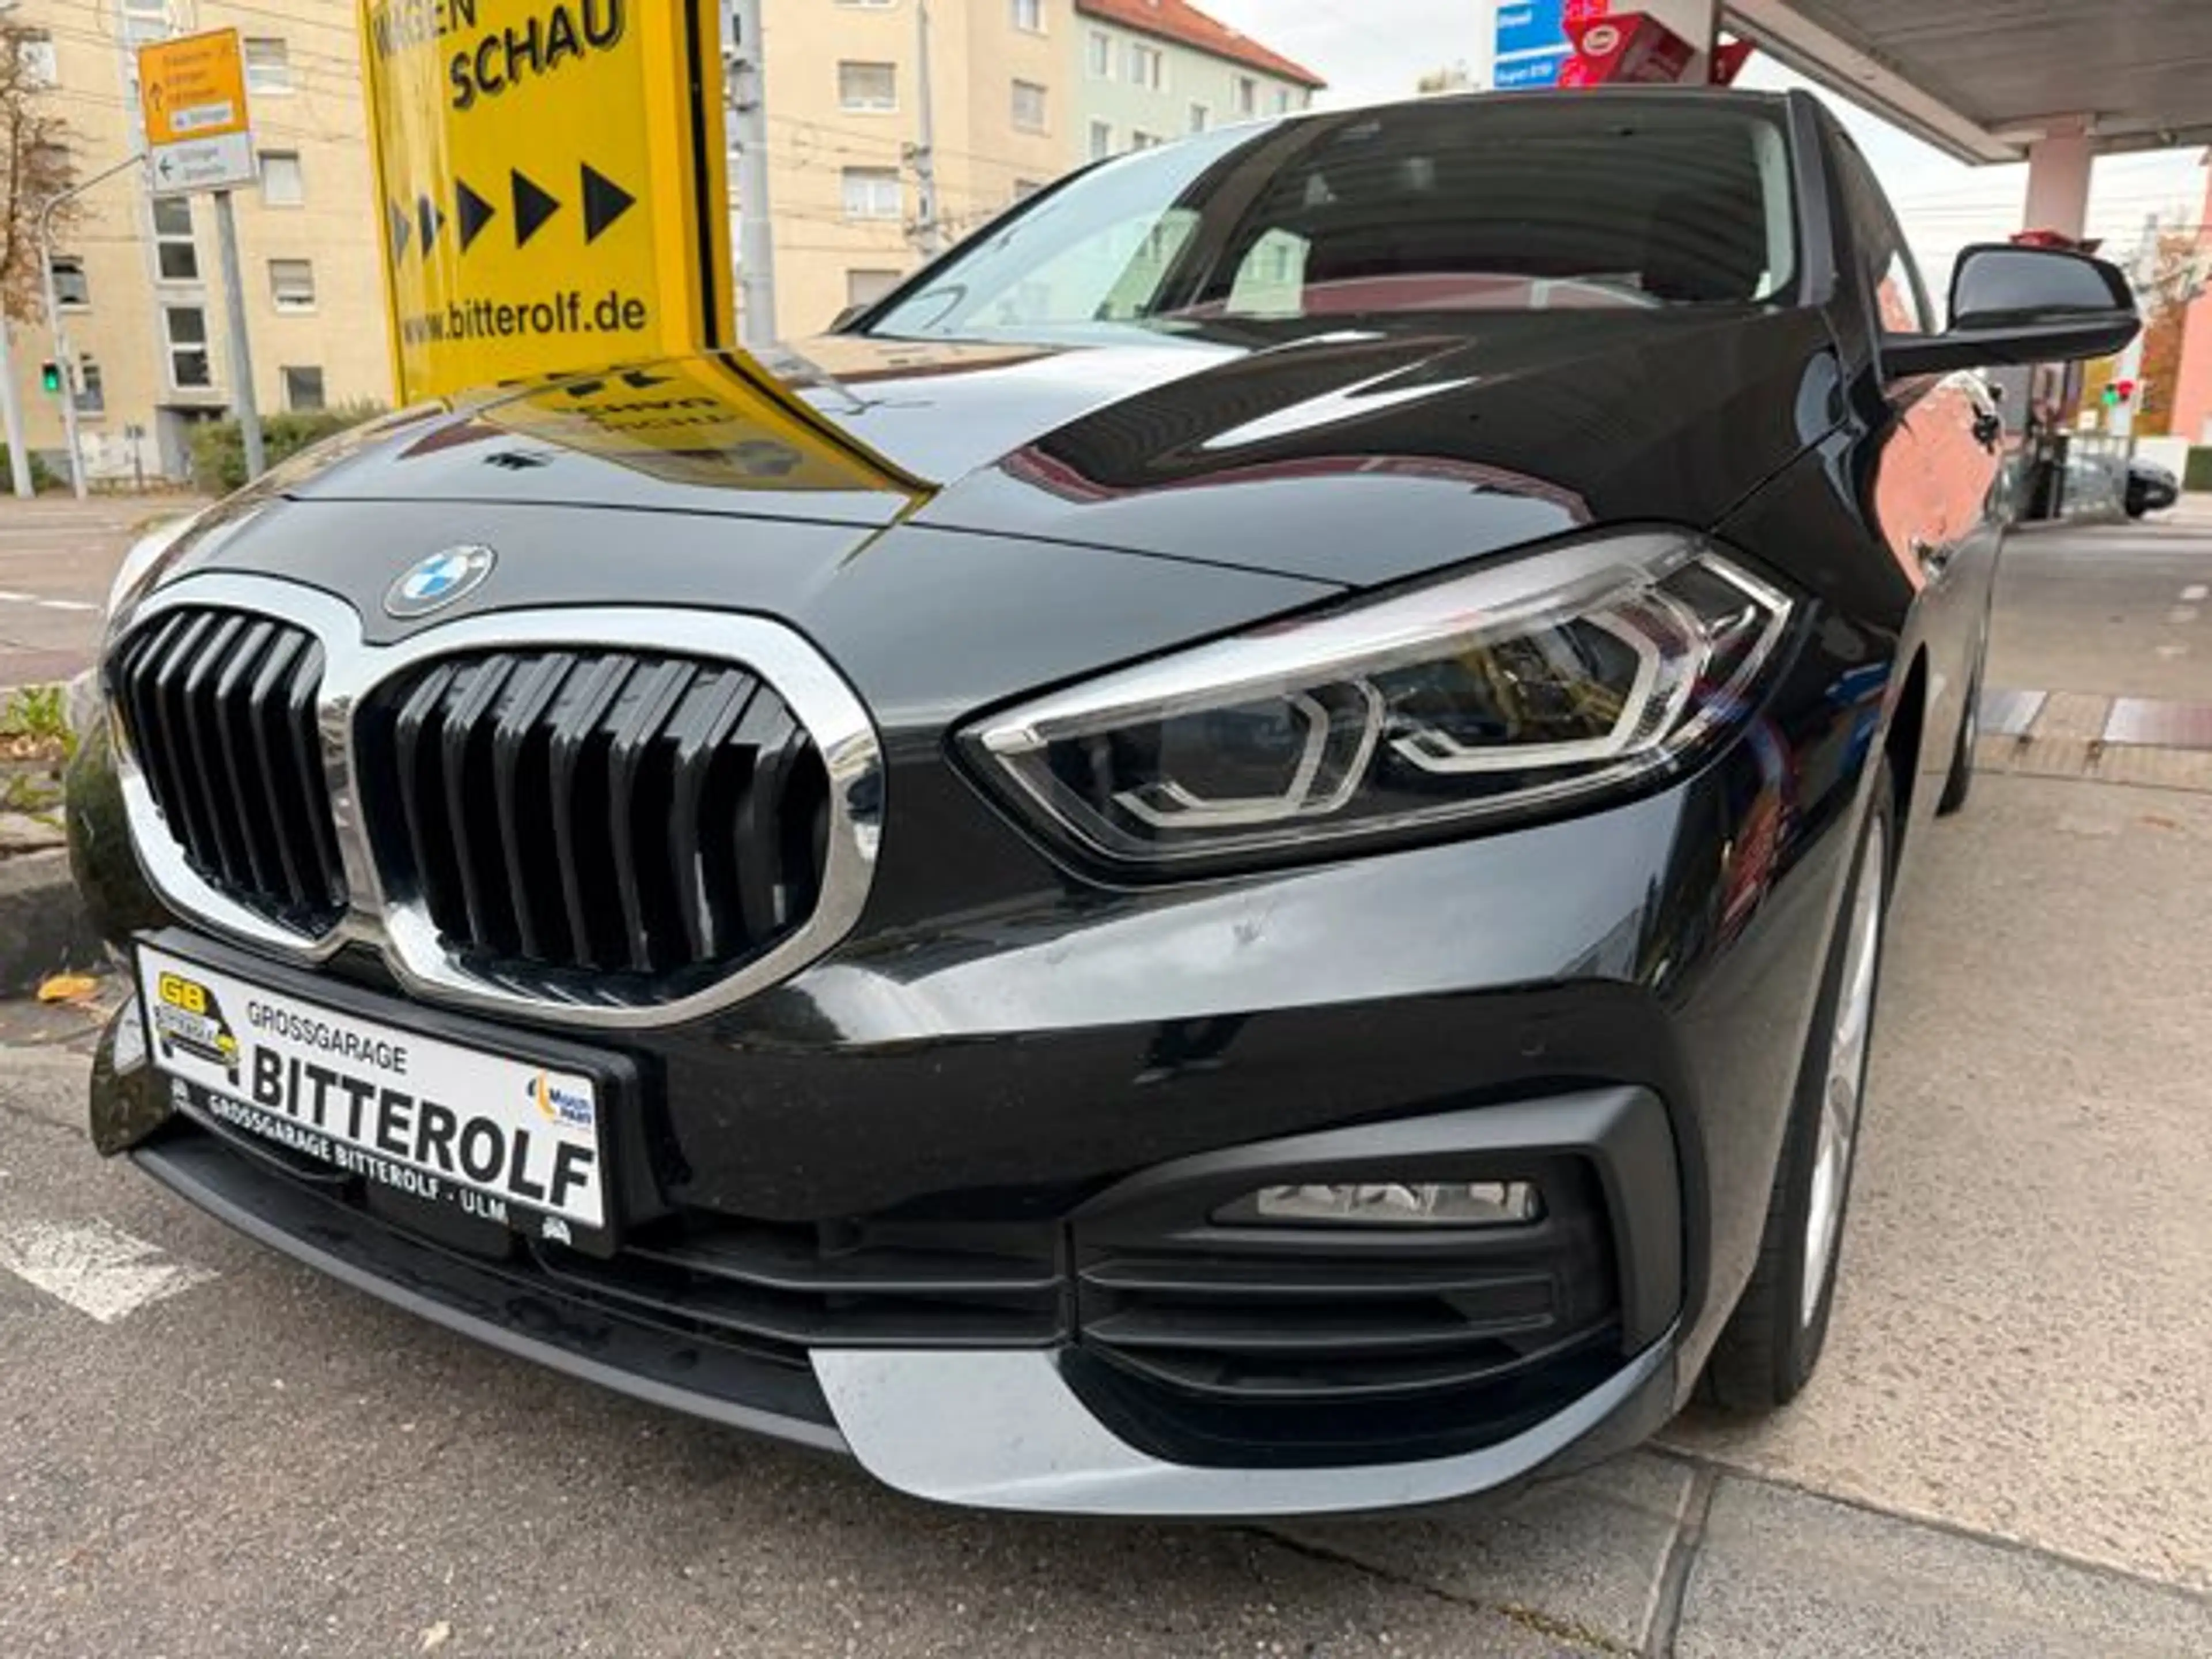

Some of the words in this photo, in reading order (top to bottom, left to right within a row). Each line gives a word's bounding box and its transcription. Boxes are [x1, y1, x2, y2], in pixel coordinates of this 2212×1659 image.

[449, 0, 626, 110] SCHAU
[404, 290, 646, 344] www.bitterolf.de
[160, 972, 206, 1014] GB
[248, 1000, 408, 1075] GROSSGARAGE
[208, 1094, 331, 1160] GROSSGARAGE
[335, 1147, 440, 1200] BITTEROLF
[460, 1189, 509, 1224] ULM
[252, 1043, 594, 1207] BITTEROLF
